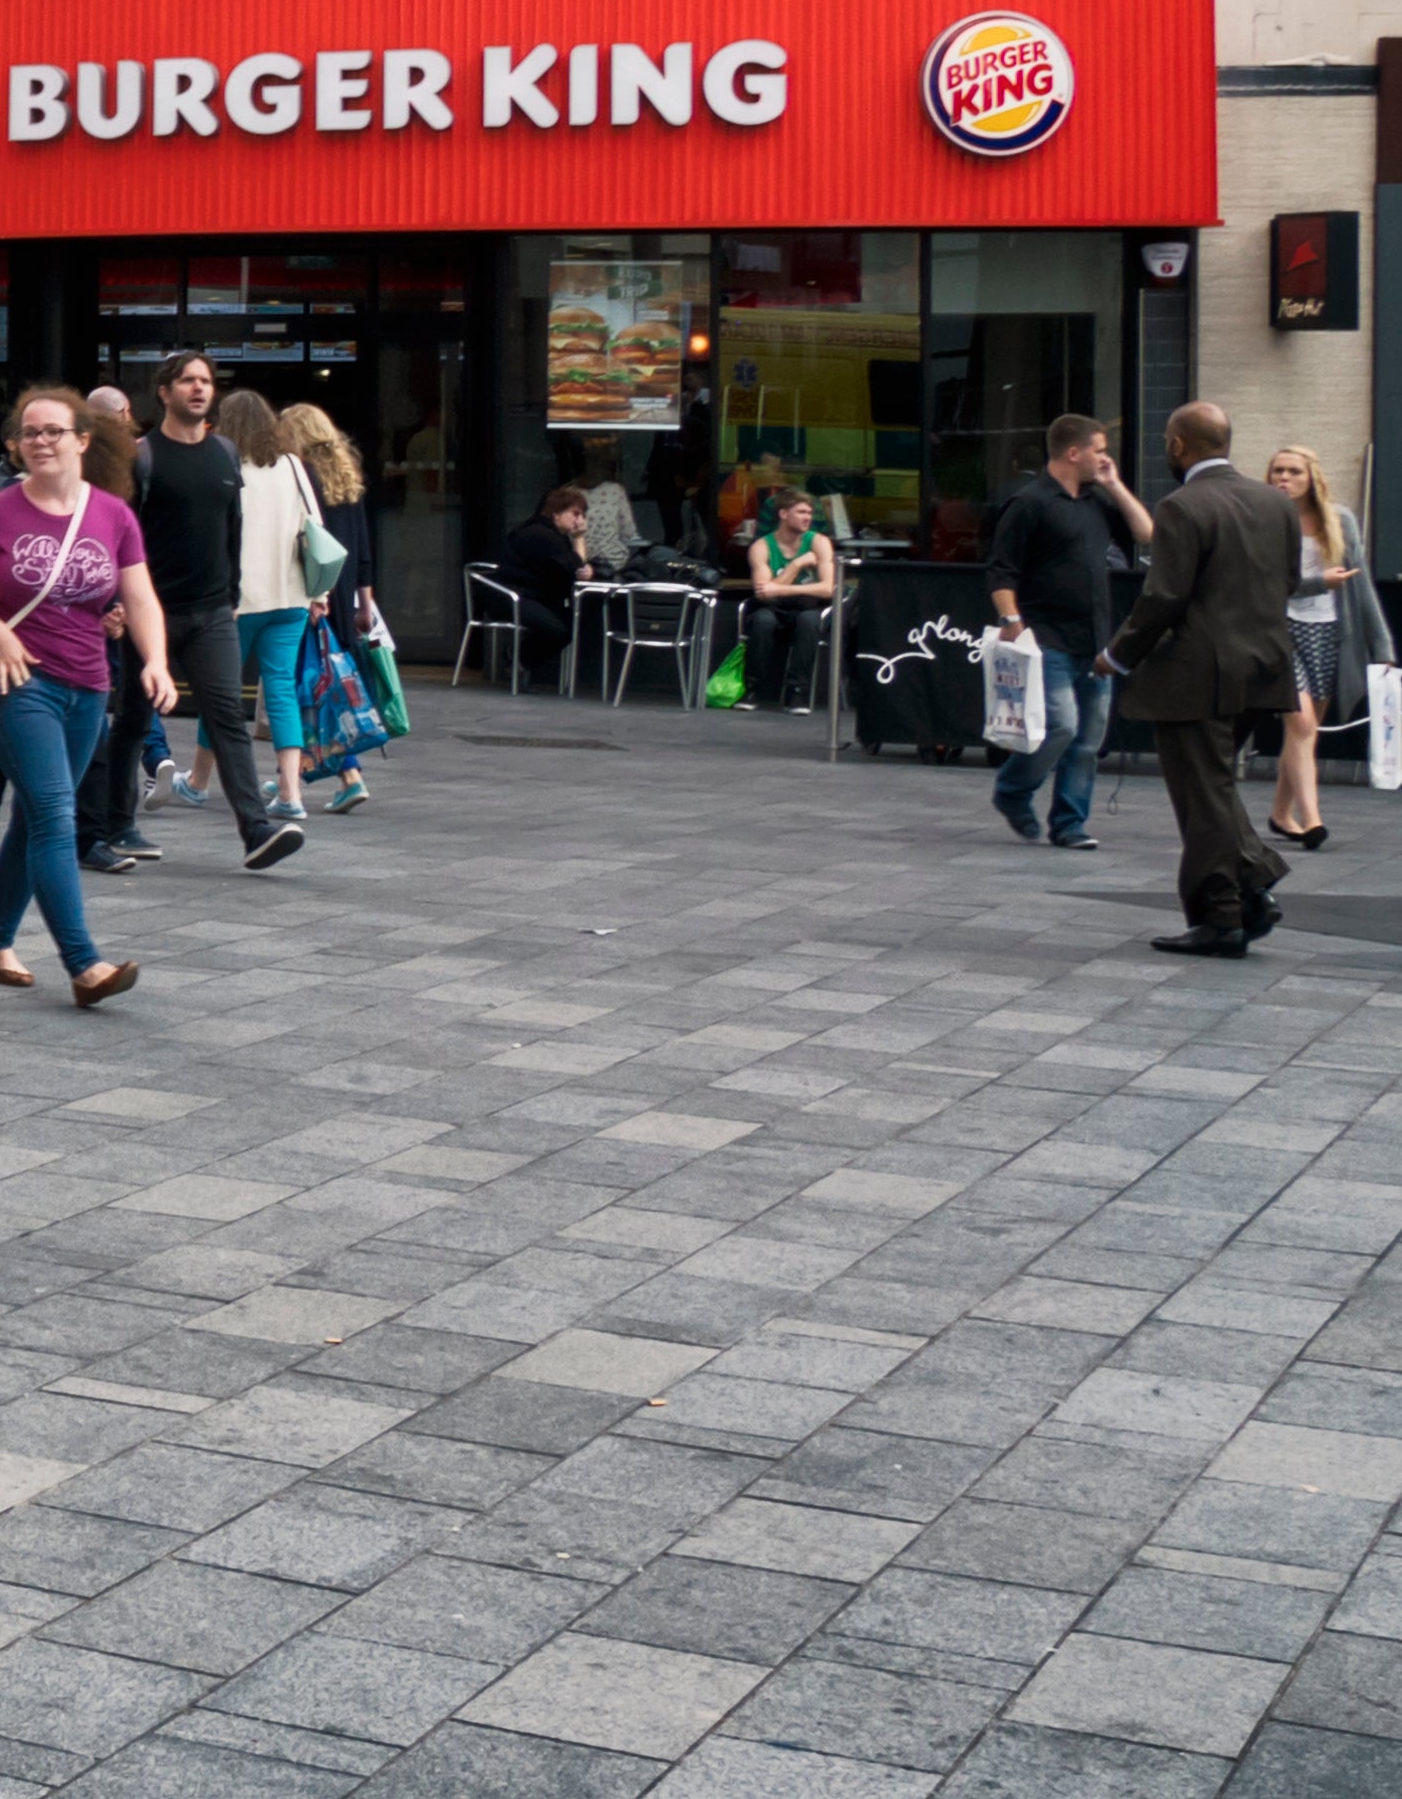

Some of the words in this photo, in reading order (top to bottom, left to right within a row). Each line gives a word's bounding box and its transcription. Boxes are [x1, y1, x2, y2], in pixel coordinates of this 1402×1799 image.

[7, 47, 454, 142] BURGER
[482, 38, 789, 129] KING
[946, 40, 1049, 91] BURGER
[951, 63, 1054, 124] KING
